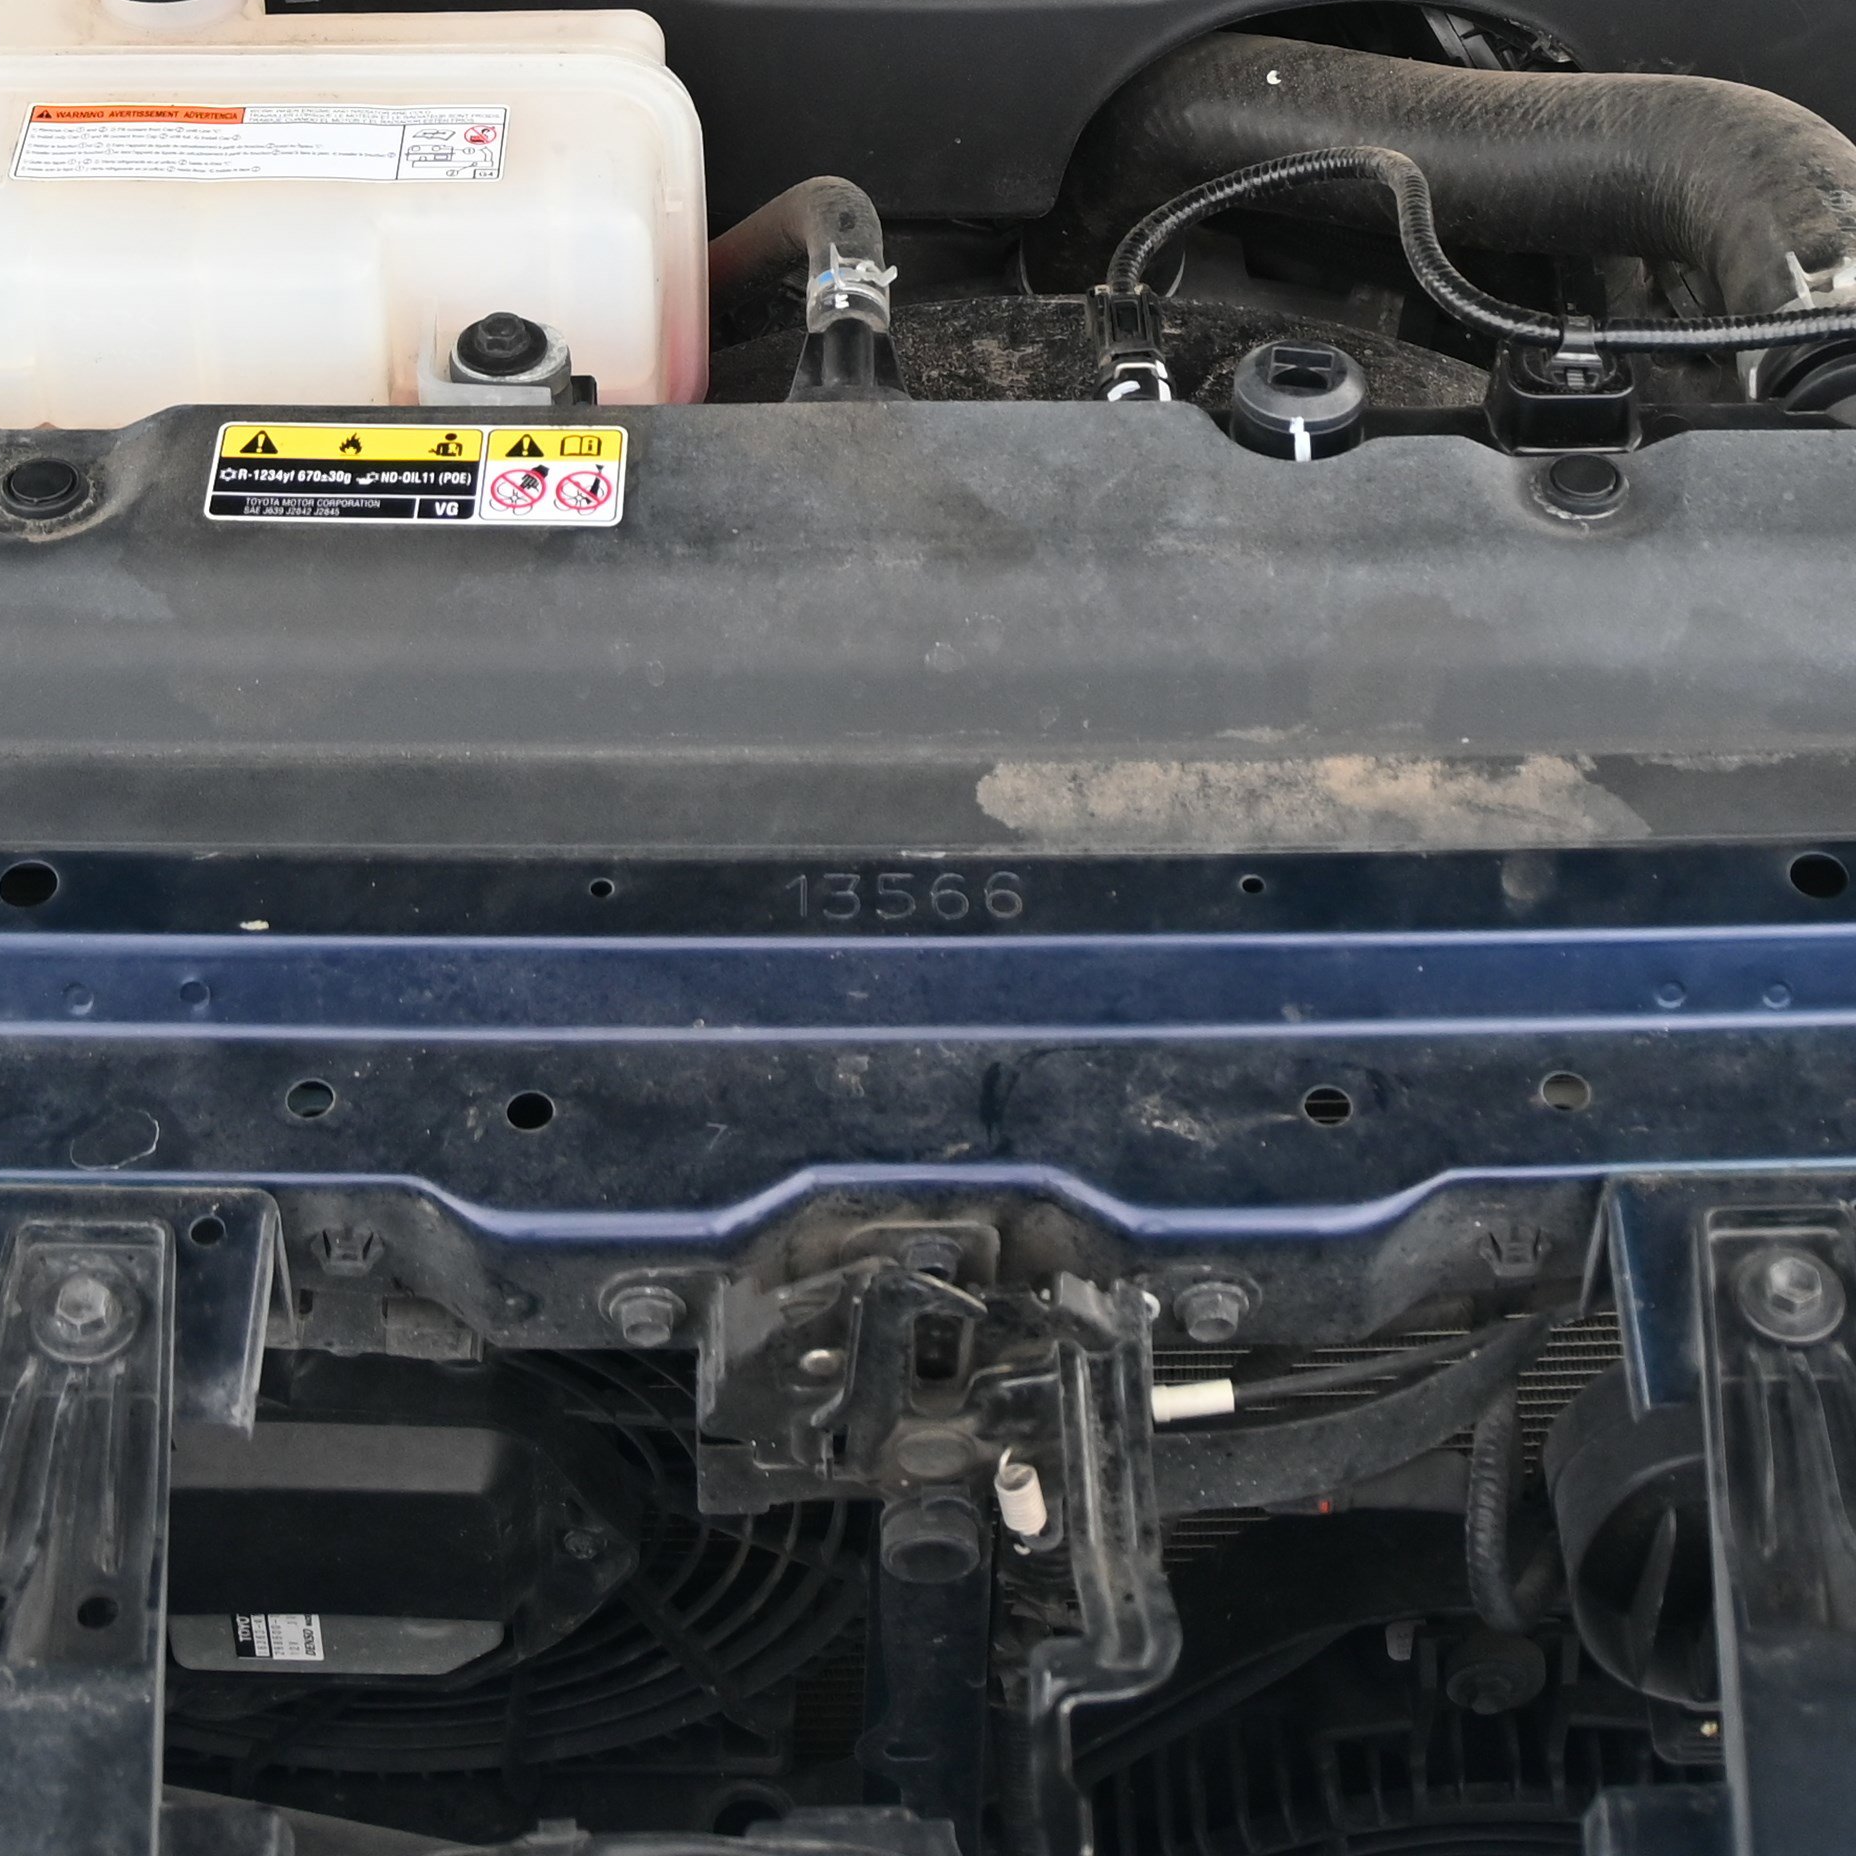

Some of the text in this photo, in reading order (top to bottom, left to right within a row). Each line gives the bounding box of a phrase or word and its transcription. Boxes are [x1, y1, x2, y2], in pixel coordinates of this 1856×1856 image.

[56, 110, 238, 120] WARNING AVERTISSEMENT ADVERTENCIA
[238, 468, 295, 484] R-1234yf
[297, 470, 352, 485] 670±30g
[439, 472, 472, 486] (POE)
[243, 505, 260, 514] SAE
[245, 497, 381, 509] TOYOTA MOTOR CORPORATION
[435, 502, 459, 516] VG
[785, 871, 1023, 920] 13566
[303, 1628, 317, 1657] DENSO
